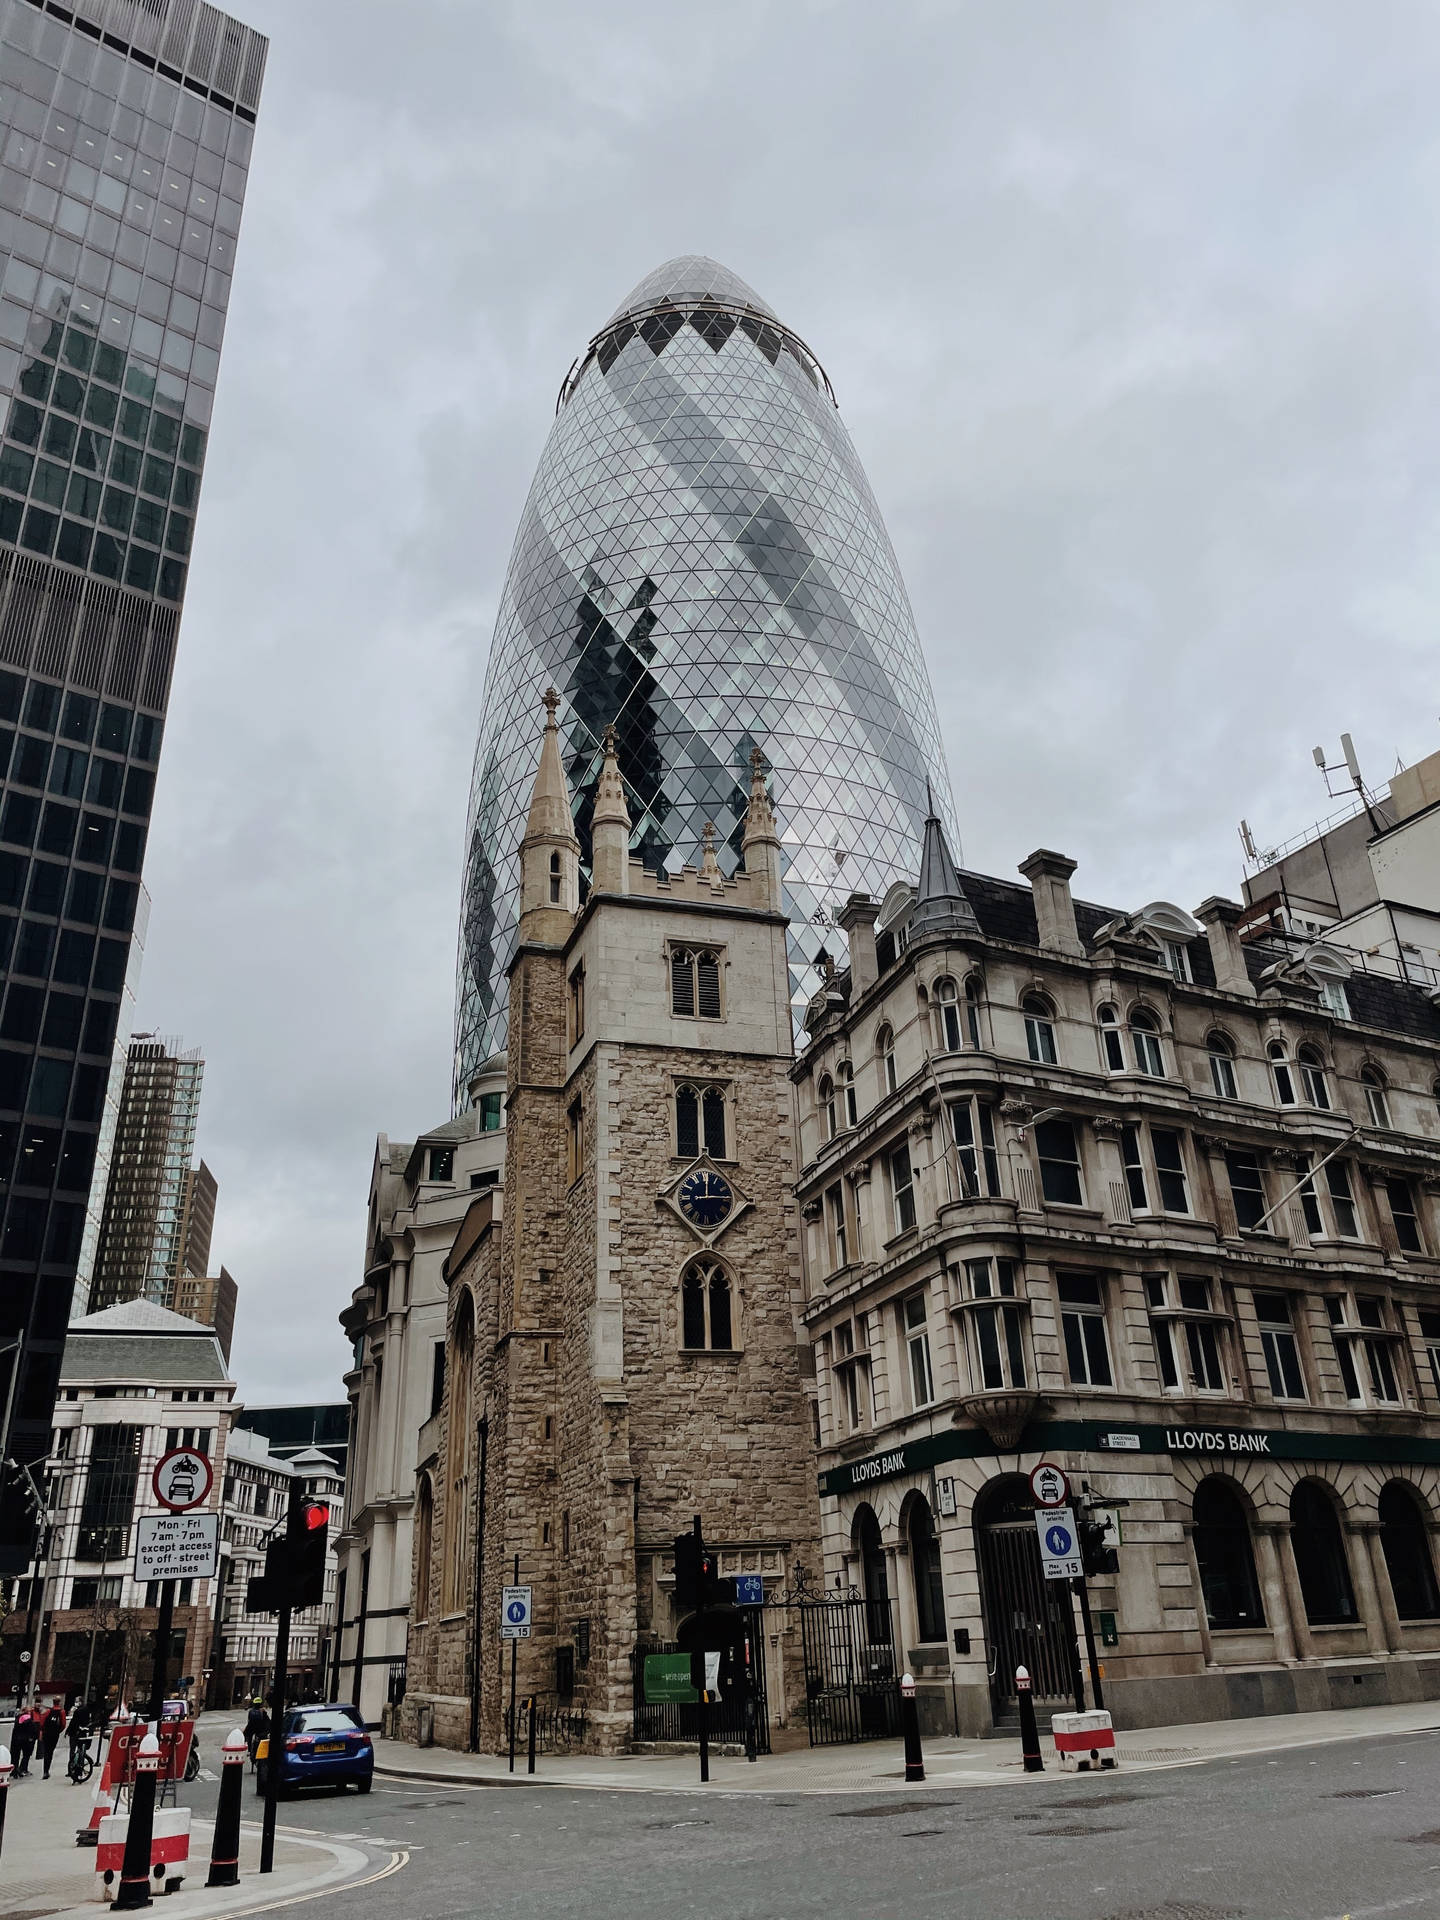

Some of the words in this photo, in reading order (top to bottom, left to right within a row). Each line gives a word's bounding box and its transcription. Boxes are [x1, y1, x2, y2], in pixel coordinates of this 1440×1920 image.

[1166, 1430, 1225, 1450] LLOYDS
[1228, 1433, 1271, 1452] BANK
[851, 1460, 880, 1483] LLOYDS
[882, 1451, 906, 1474] BANK
[157, 1520, 179, 1530] Mon
[187, 1519, 201, 1528] Fri
[141, 1543, 176, 1553] except
[179, 1542, 213, 1551] access
[143, 1555, 153, 1564] to
[179, 1552, 210, 1562] street
[152, 1565, 199, 1576] premises
[1065, 1562, 1078, 1574] 15
[517, 1627, 528, 1637] 15
[11, 1684, 41, 1693] CTA
[118, 1732, 184, 1749] CLED
